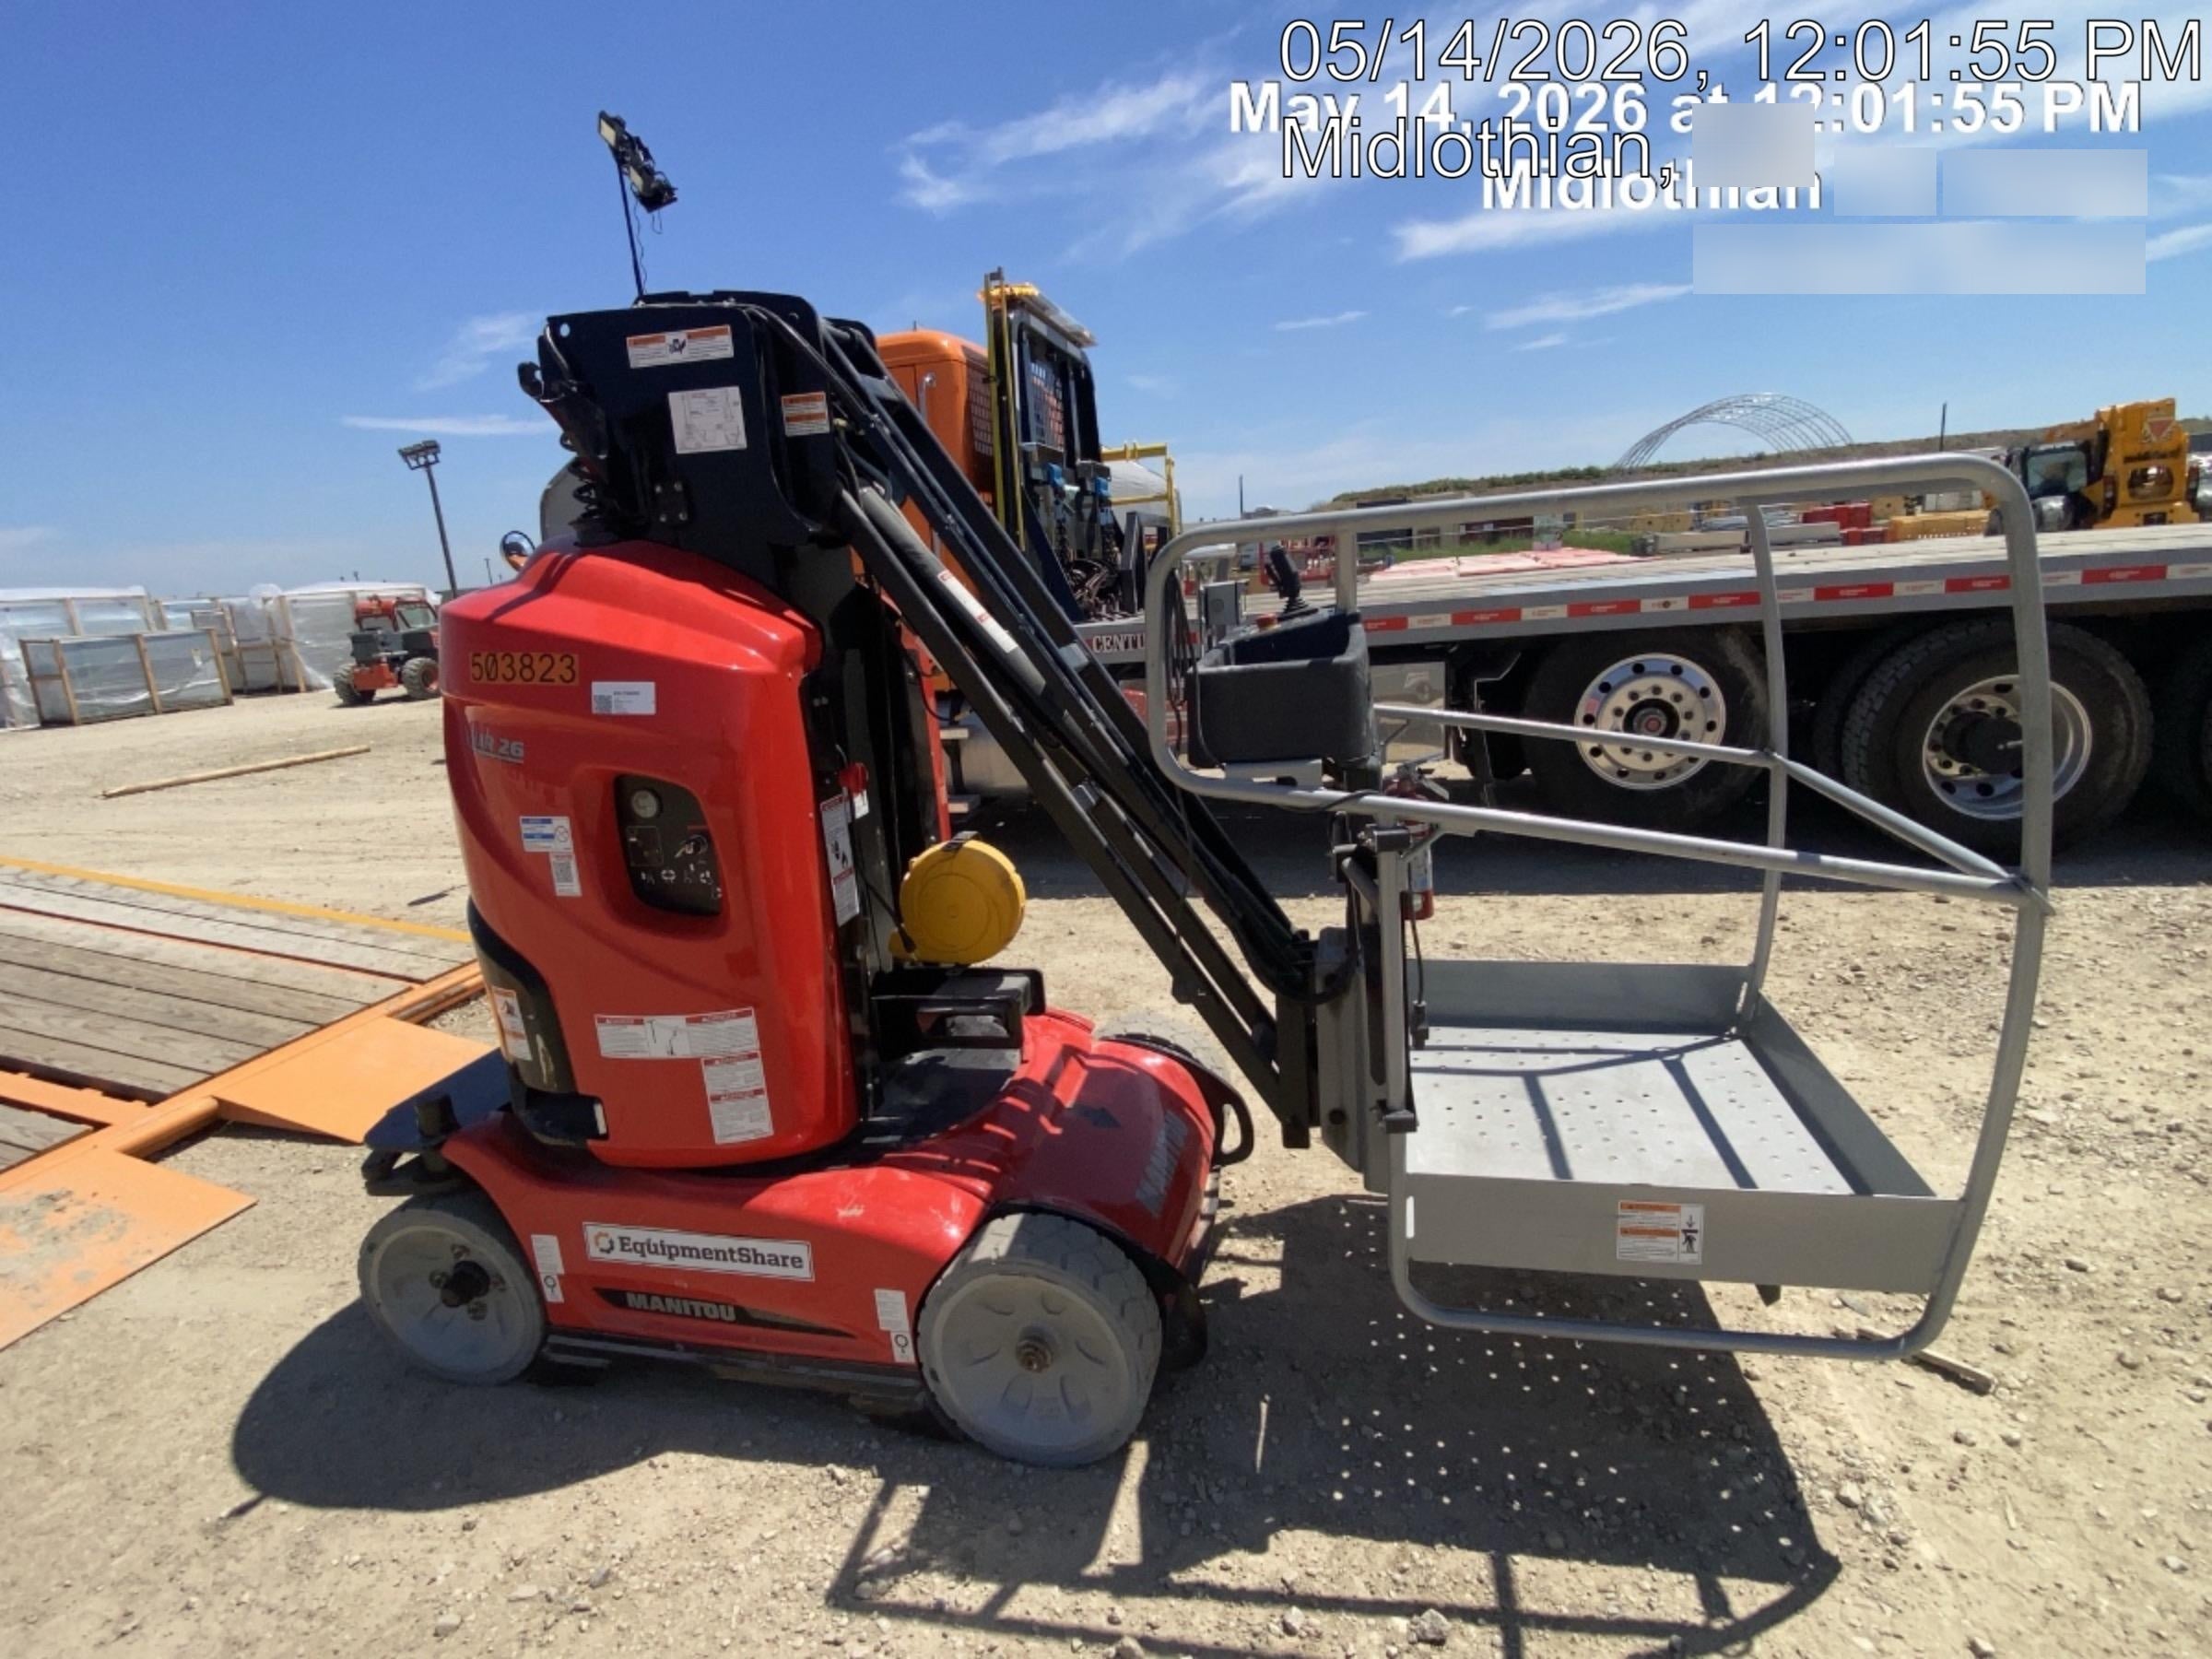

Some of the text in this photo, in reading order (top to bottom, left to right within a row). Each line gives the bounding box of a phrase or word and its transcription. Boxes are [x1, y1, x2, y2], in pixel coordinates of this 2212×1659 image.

[471, 652, 577, 684] 503823
[499, 736, 524, 759] 26
[617, 1235, 804, 1269] EquipmentShare
[626, 1290, 737, 1323] MANITOU
